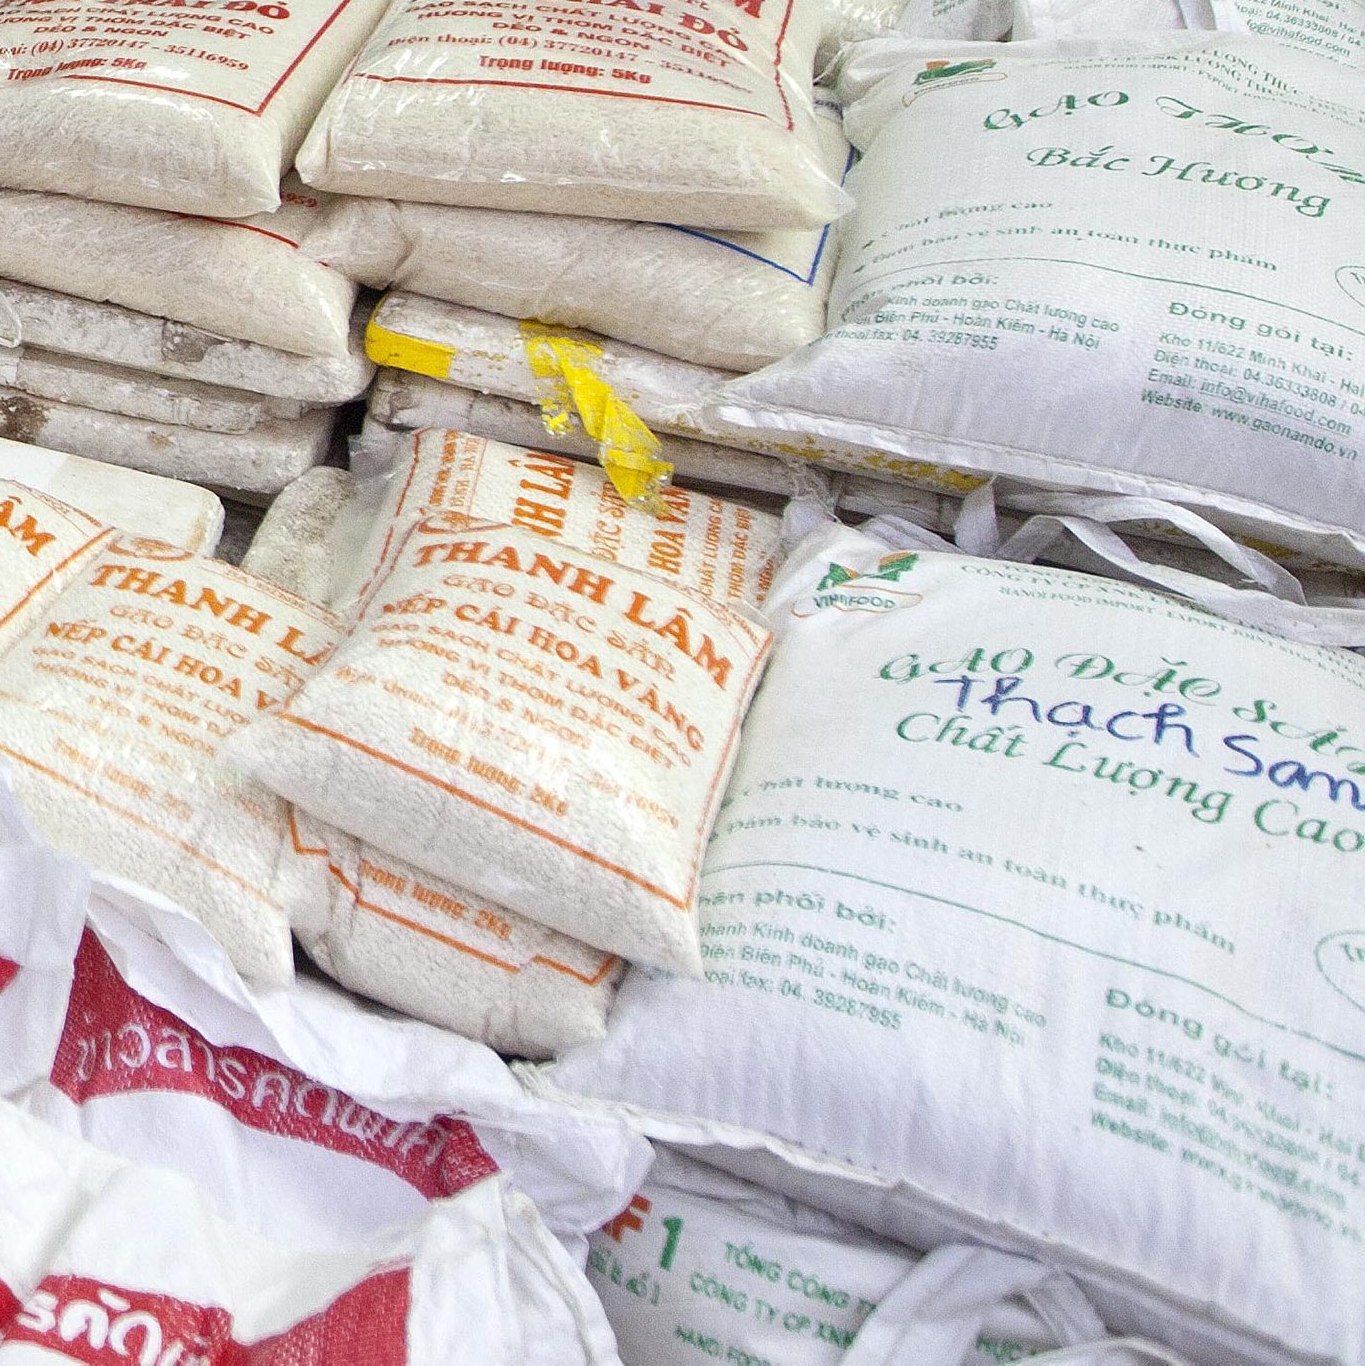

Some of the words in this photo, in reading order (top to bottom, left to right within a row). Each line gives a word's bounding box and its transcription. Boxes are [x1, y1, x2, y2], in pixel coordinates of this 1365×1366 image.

[220, 0, 293, 21] ĐỎ
[677, 11, 750, 54] ĐỎ
[575, 31, 651, 52] NGON
[477, 55, 534, 74] Trọng
[540, 58, 605, 80] lượng:
[610, 66, 653, 86] 5Kg
[983, 89, 1132, 133] GẠO
[1027, 145, 1131, 173] Bắc
[1141, 154, 1332, 219] Hương
[1091, 318, 1121, 332] cao
[1168, 301, 1247, 331] Đóng
[1256, 321, 1301, 344] gói
[1310, 335, 1354, 362] tại:
[1159, 332, 1191, 348] Kho
[1197, 337, 1247, 359] 11/622
[1248, 349, 1287, 371] Minh
[1211, 407, 1360, 462] www.gaonamdo.vn
[88, 563, 274, 637] THANH
[411, 540, 611, 607] THANH
[621, 588, 736, 693] LÂM
[111, 632, 167, 668] CÁI
[174, 653, 244, 701] HOA
[455, 597, 519, 637] CÁI
[528, 626, 605, 682] HOA
[617, 669, 707, 755] VÀNG
[934, 675, 1201, 758] Thạch
[896, 712, 1030, 759] Chất
[1041, 740, 1236, 824] Lượng
[1253, 798, 1365, 853] Cao
[908, 793, 966, 812] cao
[889, 826, 950, 858] sinh
[957, 846, 997, 866] an
[689, 1270, 750, 1314] CÔNG
[787, 1266, 850, 1312] CÔNG
